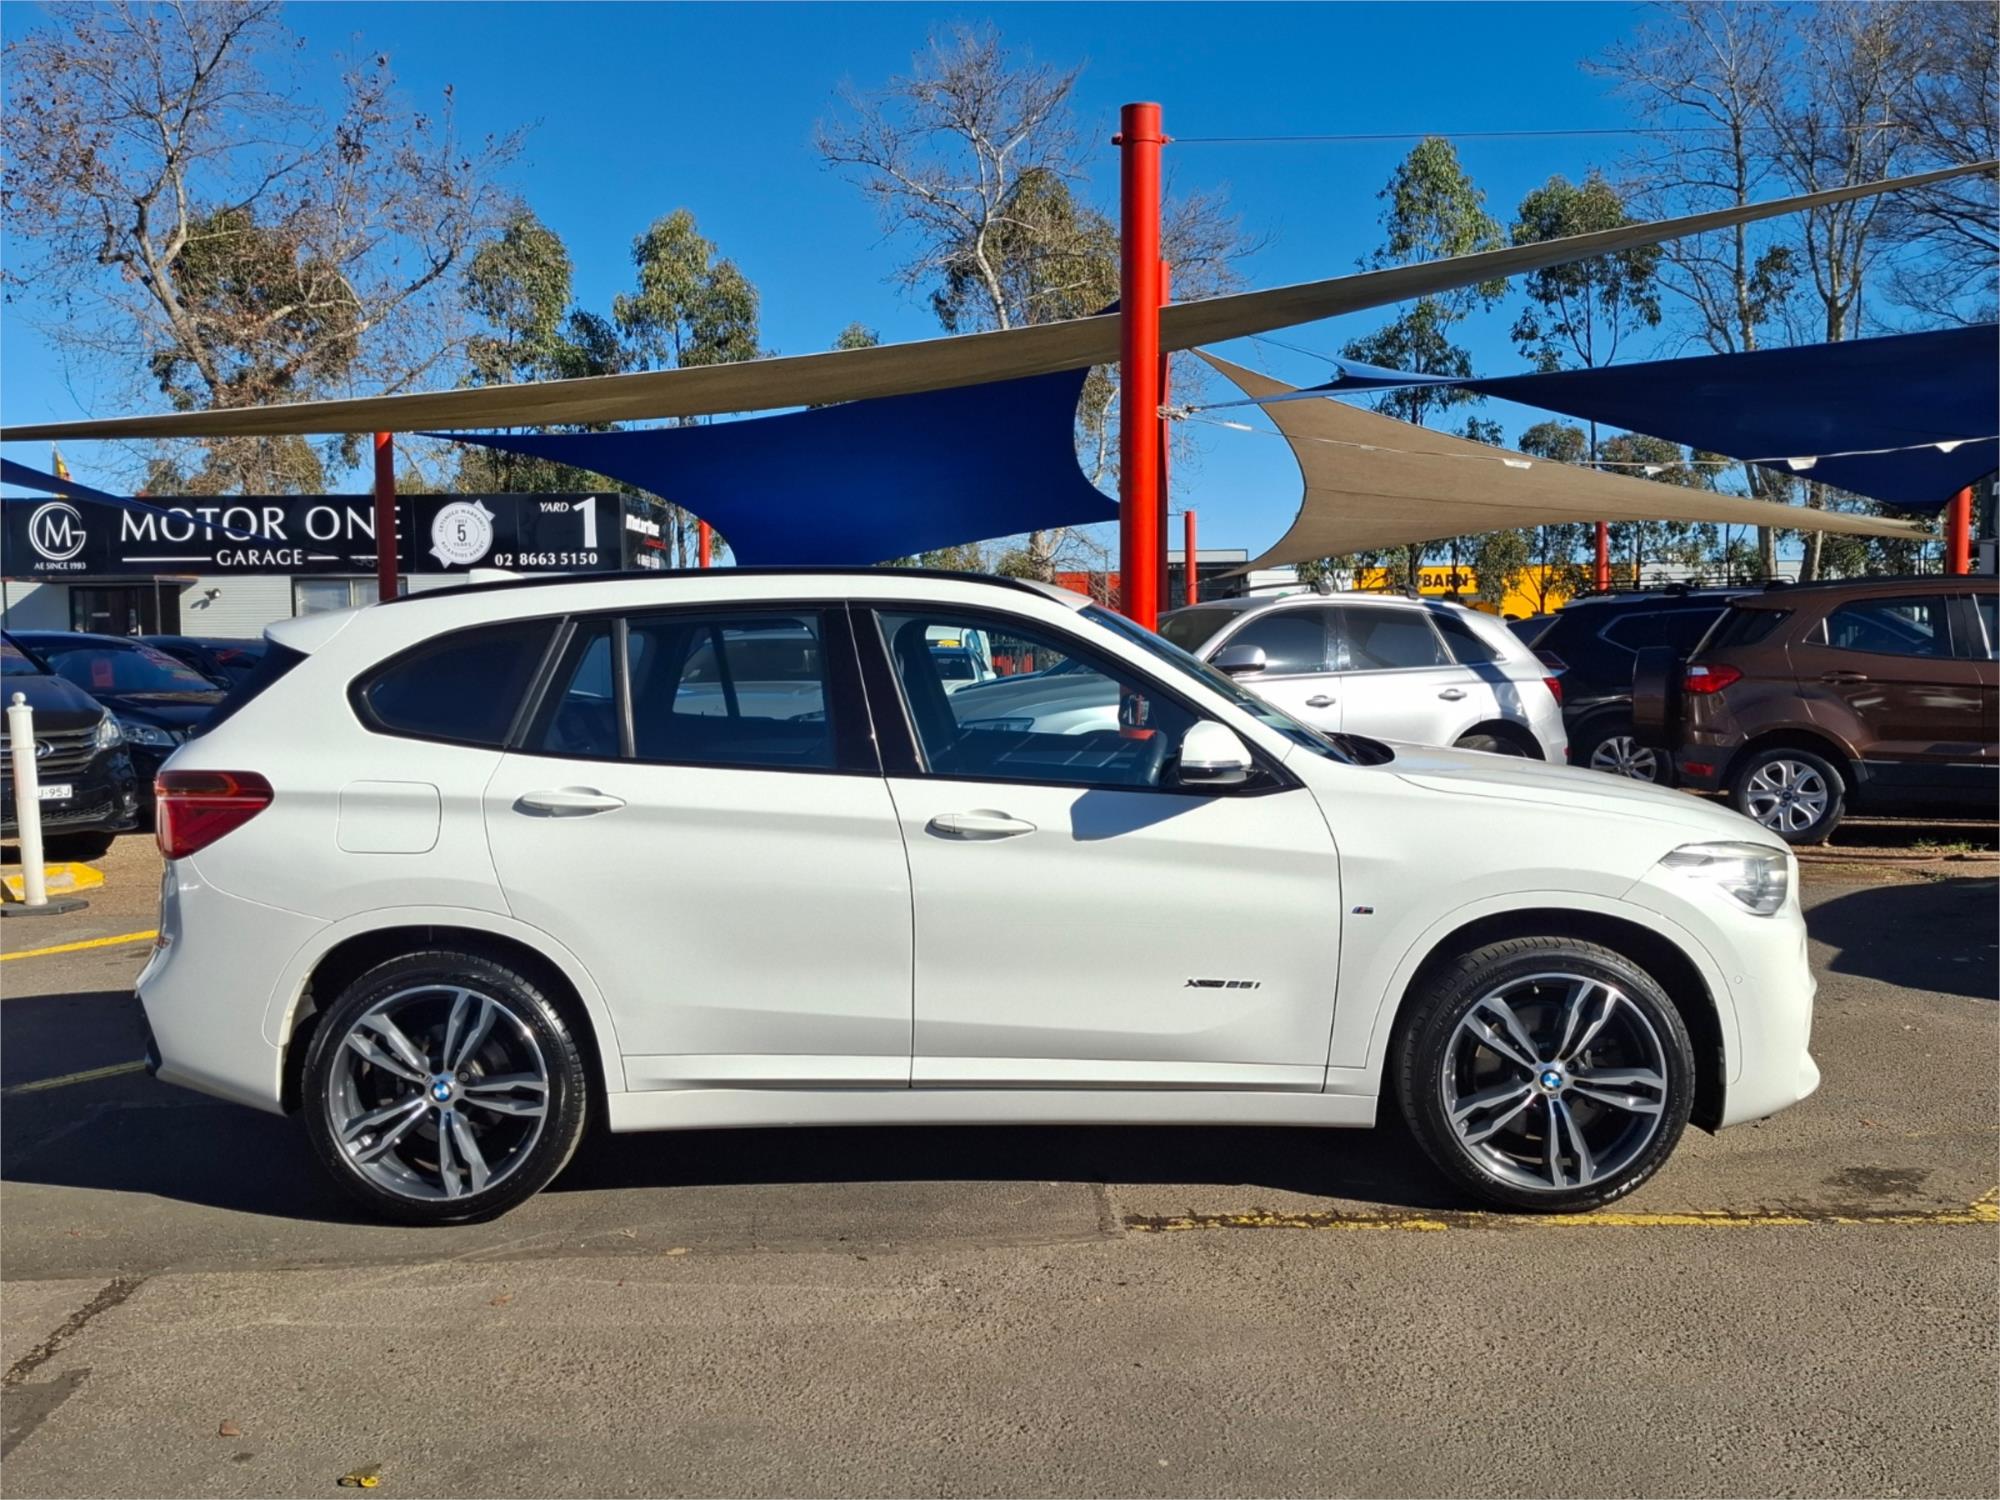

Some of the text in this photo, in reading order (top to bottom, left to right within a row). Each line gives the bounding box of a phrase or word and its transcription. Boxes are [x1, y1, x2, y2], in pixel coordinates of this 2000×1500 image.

[120, 507, 288, 542] MOTOR
[539, 502, 570, 513] YARD
[572, 496, 598, 548] 1
[457, 524, 467, 542] 5
[216, 549, 303, 565] GARAGE
[495, 552, 598, 566] 02 8663 5150
[46, 562, 68, 570] SINCE
